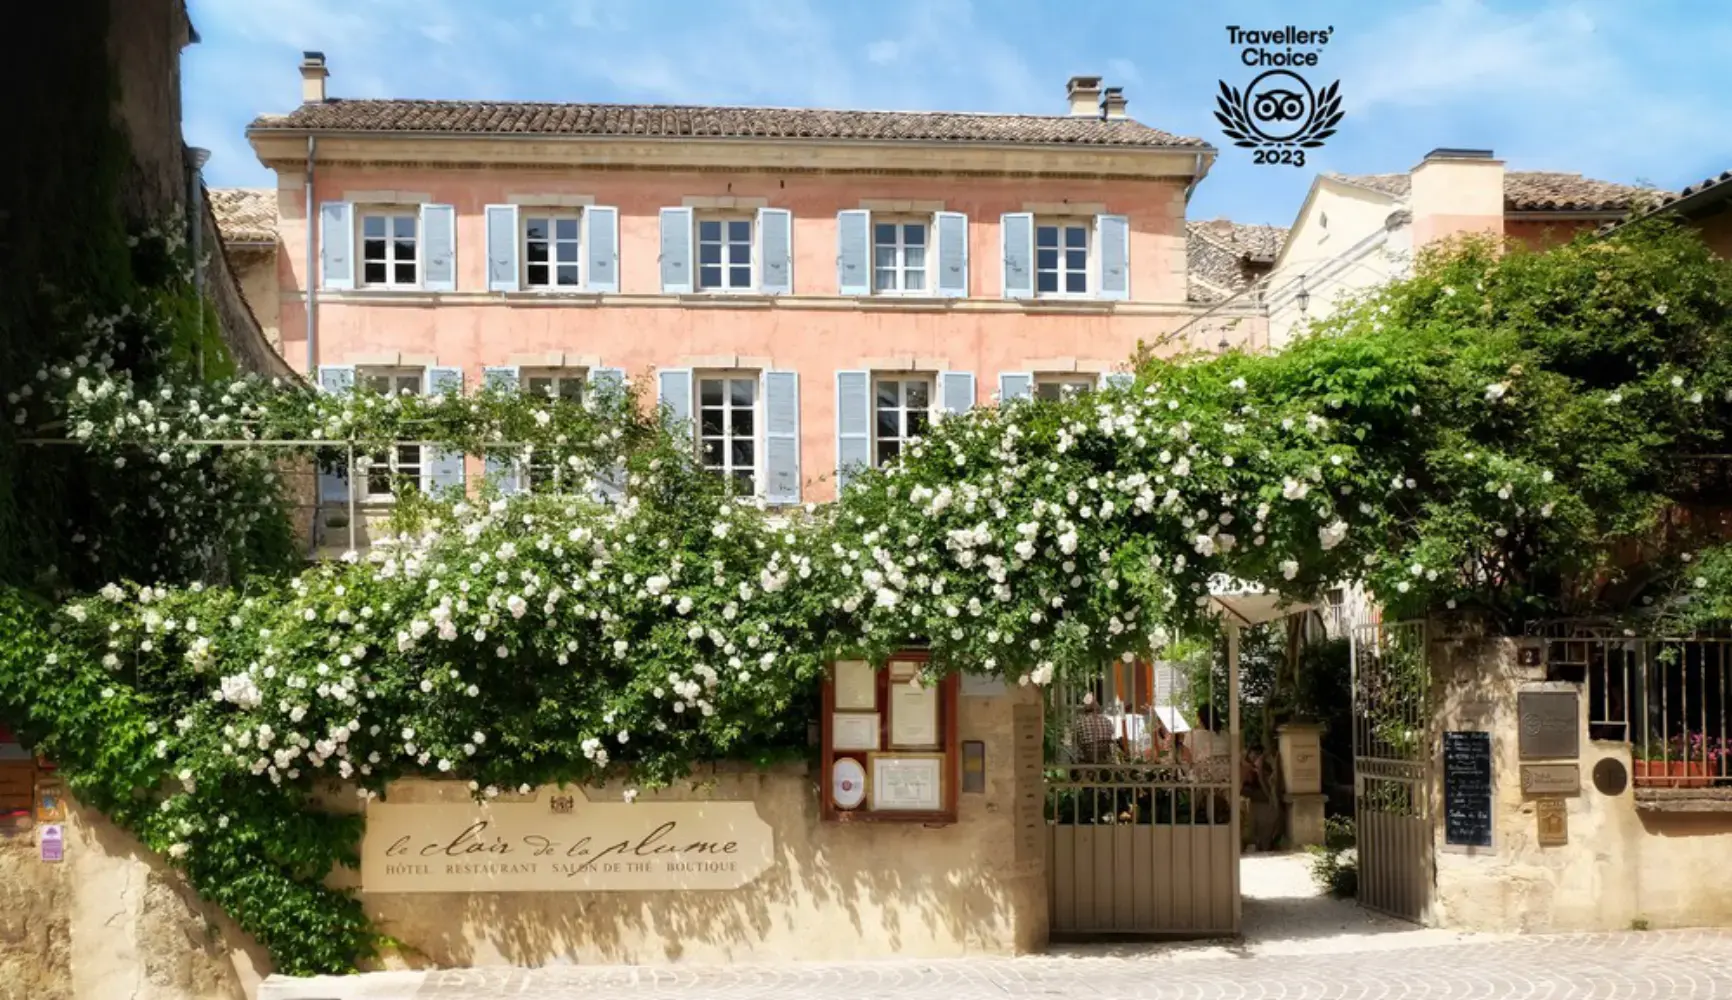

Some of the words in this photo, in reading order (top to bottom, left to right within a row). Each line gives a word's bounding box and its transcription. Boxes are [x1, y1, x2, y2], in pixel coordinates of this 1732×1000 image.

[385, 835, 410, 857] le
[419, 820, 514, 857] clair
[523, 835, 562, 857] de
[566, 836, 592, 857] la
[567, 821, 738, 877] plume
[446, 863, 538, 875] RESTAURANT
[552, 863, 597, 874] SALON
[603, 863, 621, 873] DE
[667, 861, 737, 874] BOUTIQUE
